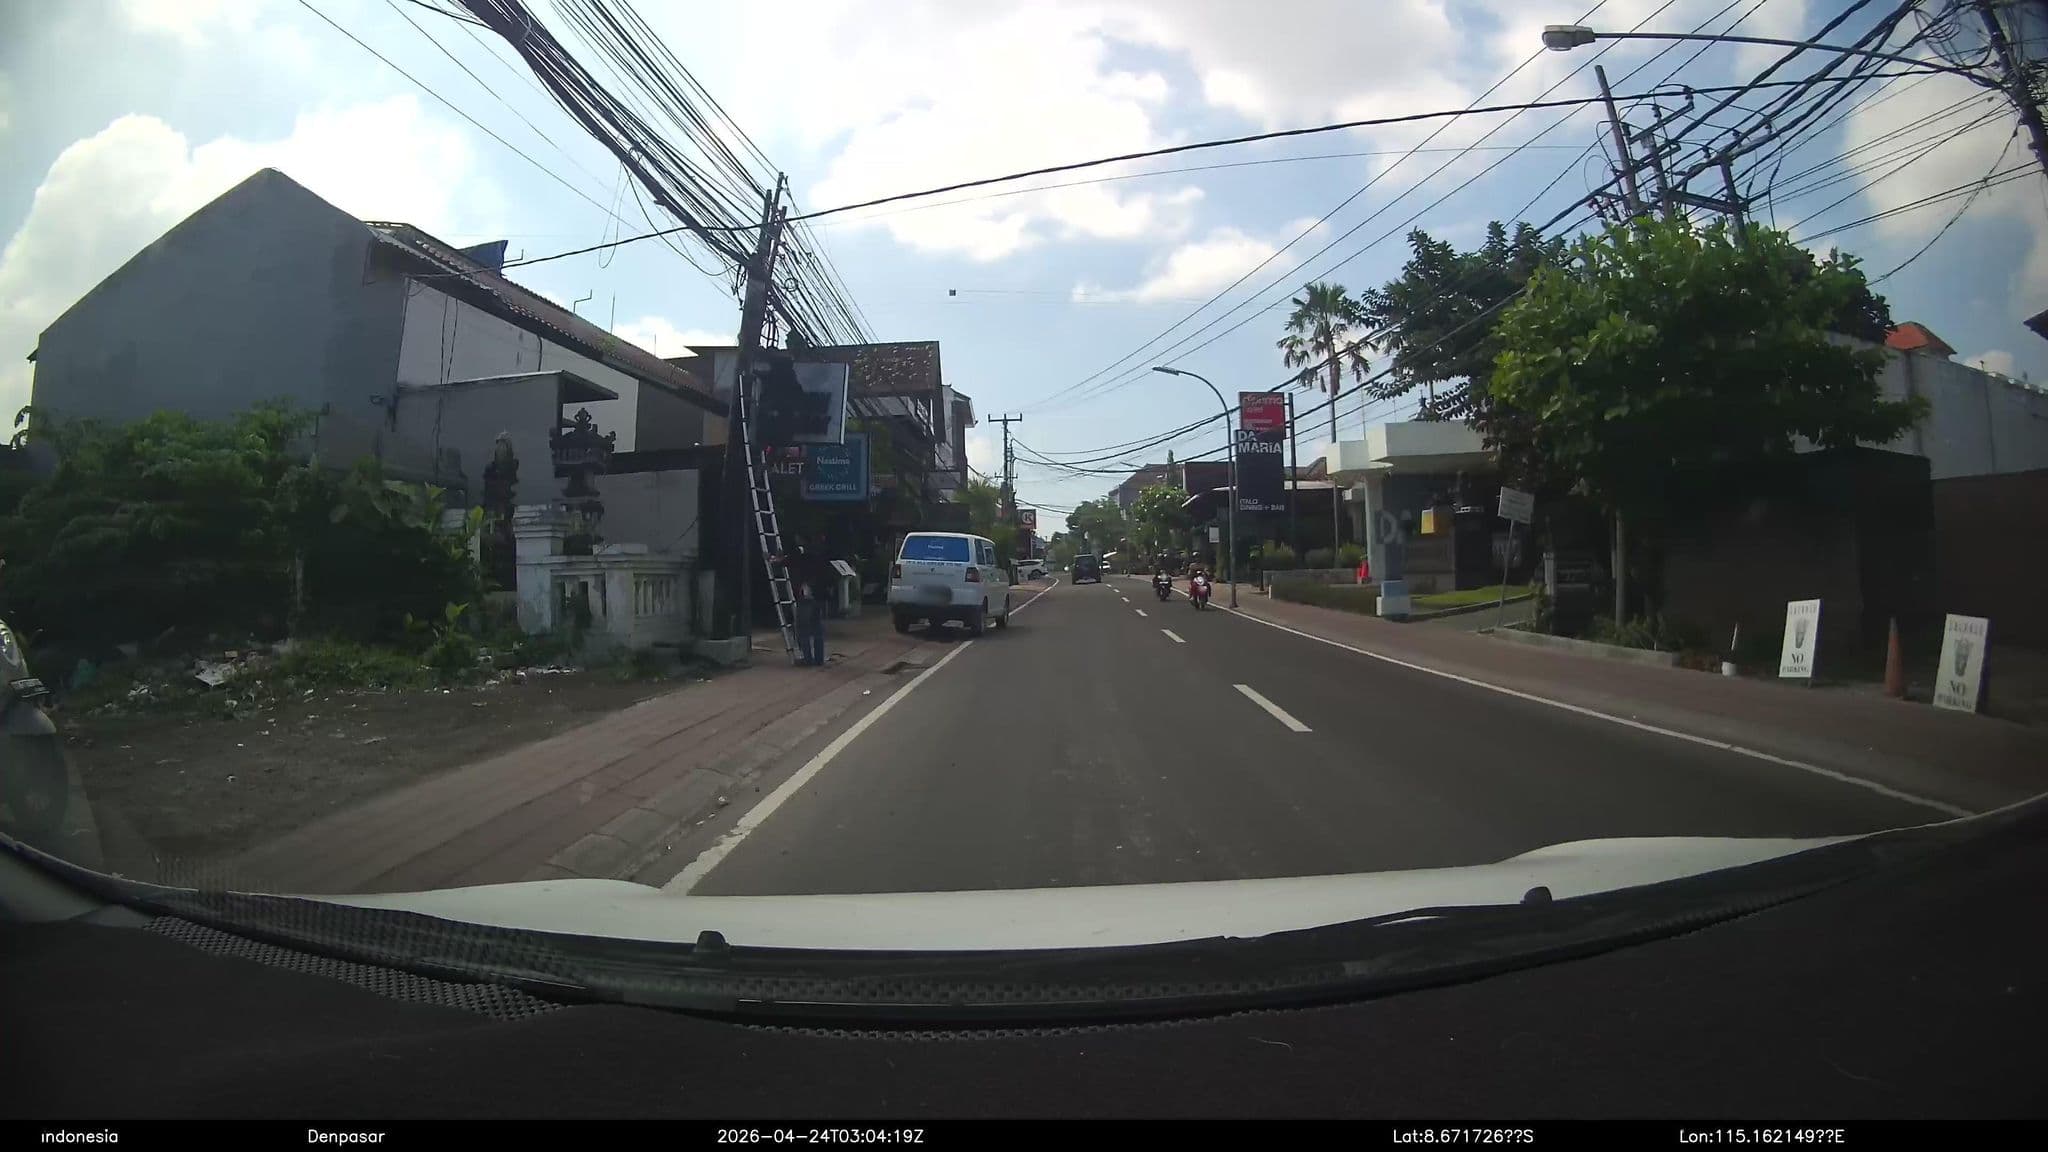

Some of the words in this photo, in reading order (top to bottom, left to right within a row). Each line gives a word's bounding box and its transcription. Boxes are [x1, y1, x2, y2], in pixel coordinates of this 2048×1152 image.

[1237, 430, 1257, 441] DA
[769, 462, 804, 475] ALET
[1791, 653, 1805, 664] NO
[1949, 680, 1967, 697] NO
